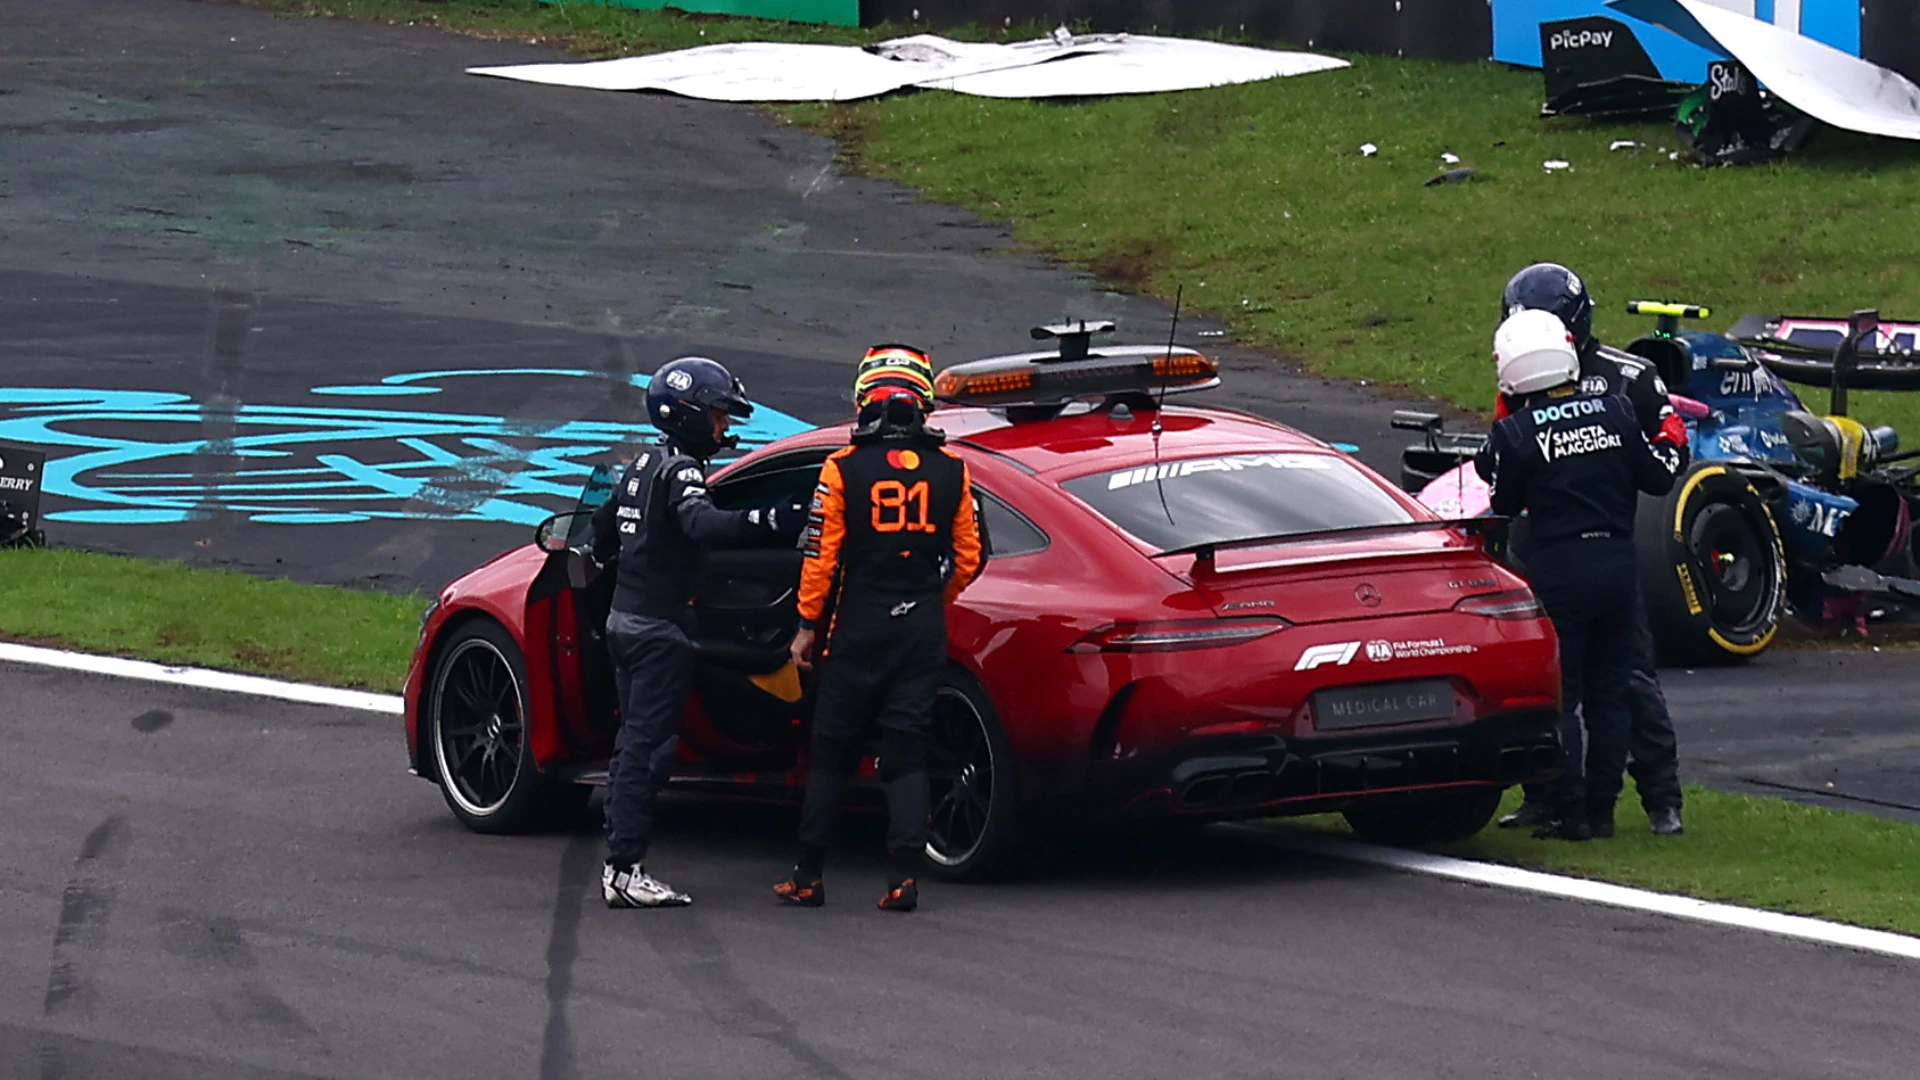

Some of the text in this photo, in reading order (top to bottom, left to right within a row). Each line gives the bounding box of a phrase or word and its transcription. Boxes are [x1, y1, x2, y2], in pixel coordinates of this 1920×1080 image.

[1550, 29, 1613, 50] PicPay
[1581, 376, 1609, 396] FIA
[1532, 399, 1607, 426] DOCTOR
[1552, 424, 1607, 446] SANCTA
[1554, 434, 1623, 459] MAGGIORI
[870, 479, 937, 534] 81
[1294, 641, 1362, 671] F1
[1366, 639, 1393, 662] FIA
[1331, 691, 1438, 717] MEDICAL CAR
